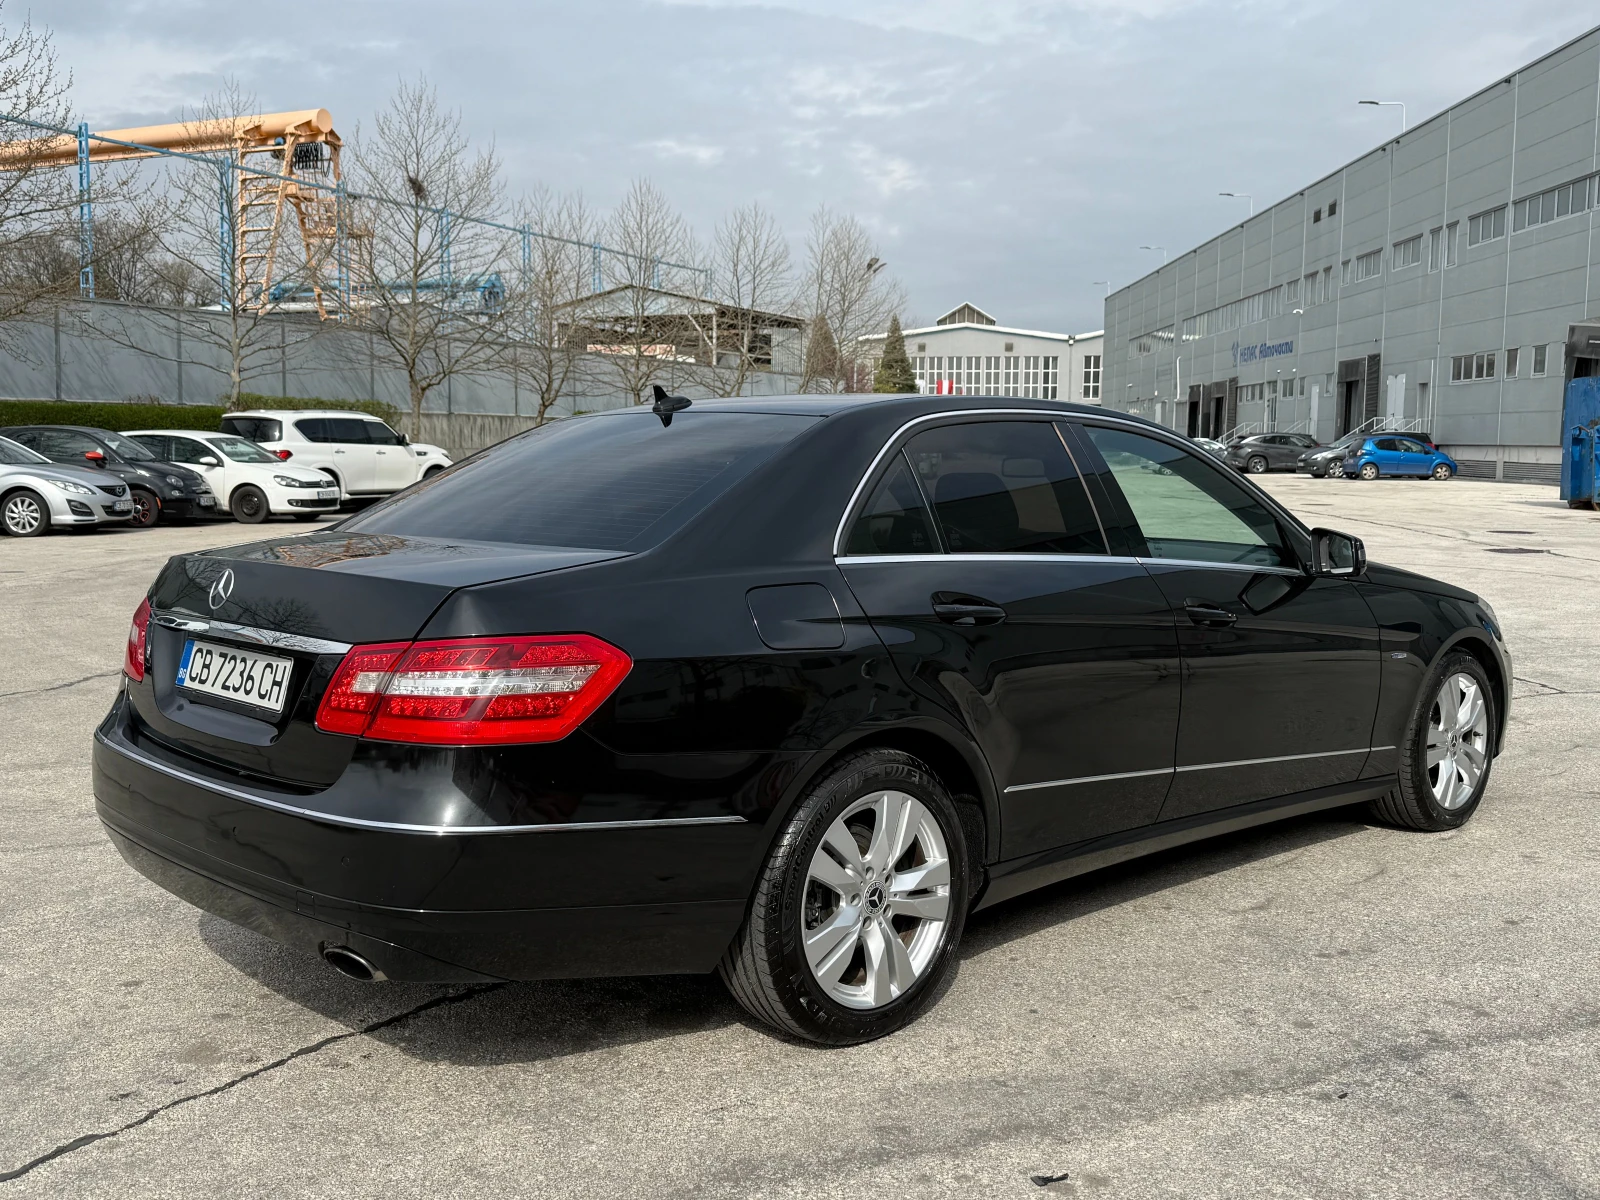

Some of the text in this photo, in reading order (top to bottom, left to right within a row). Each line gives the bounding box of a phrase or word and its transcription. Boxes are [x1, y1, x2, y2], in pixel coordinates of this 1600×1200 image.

[189, 648, 286, 703] CB 7236 CH
[784, 810, 825, 911] SportControl
